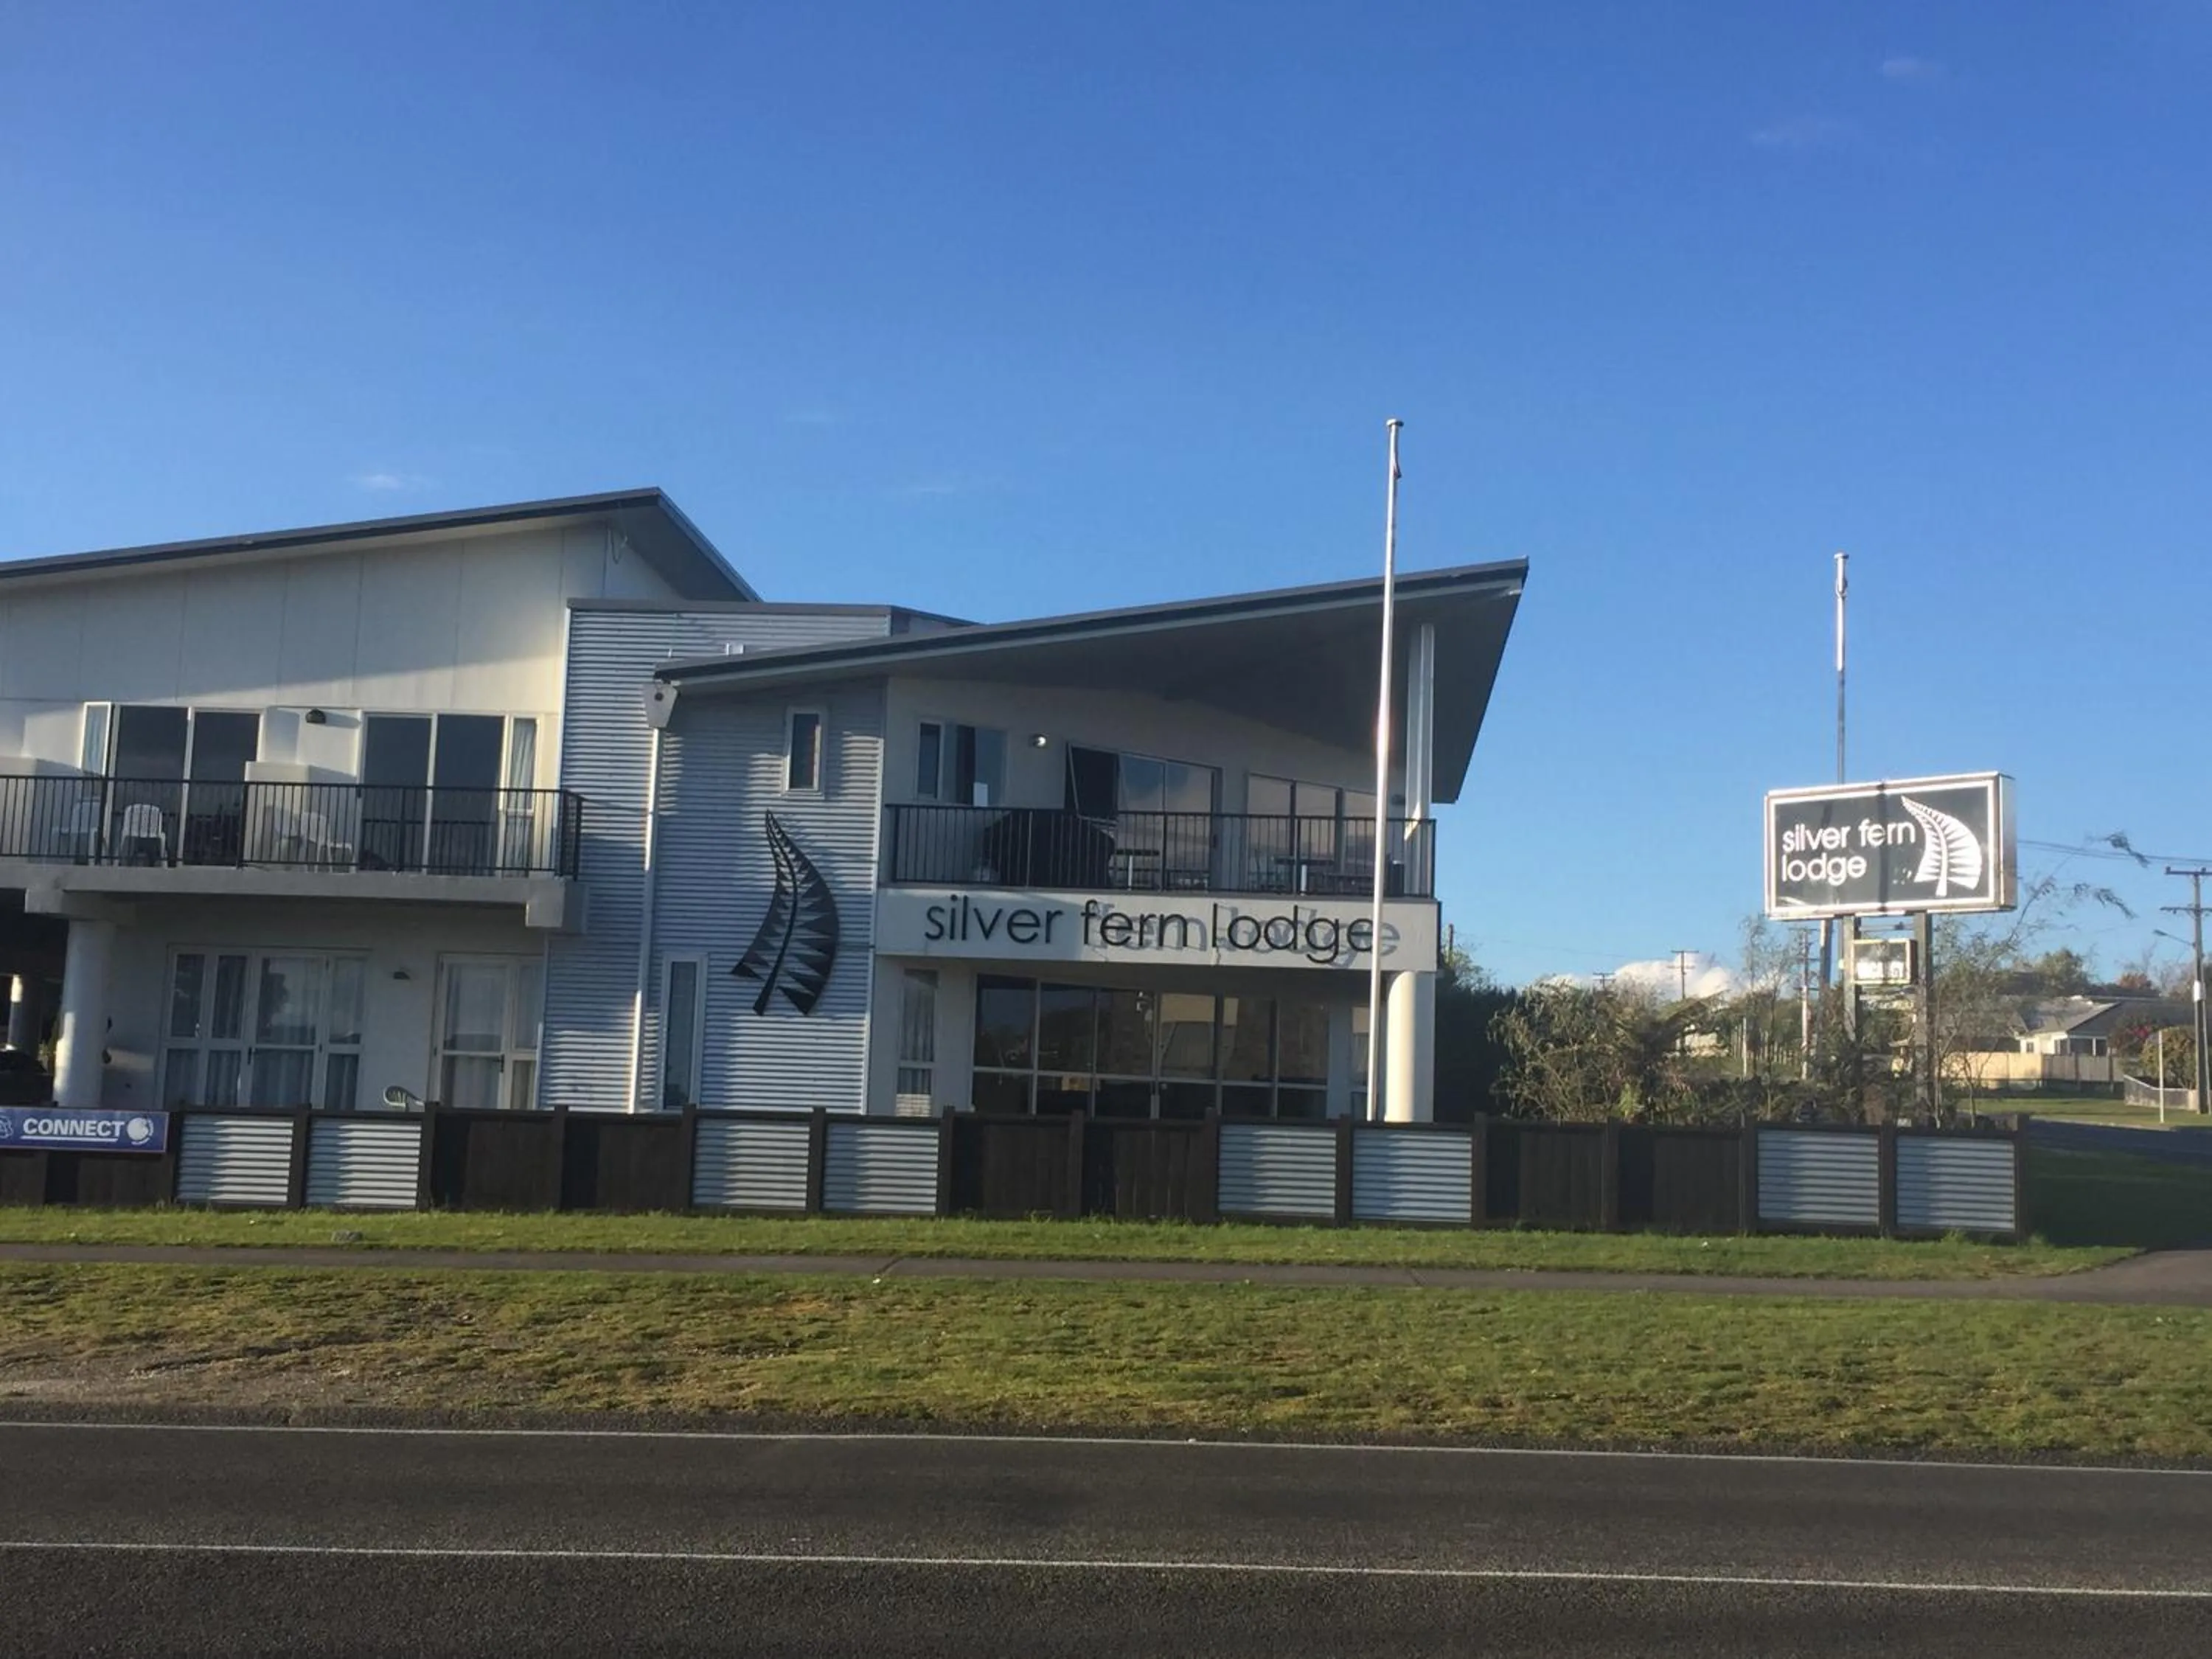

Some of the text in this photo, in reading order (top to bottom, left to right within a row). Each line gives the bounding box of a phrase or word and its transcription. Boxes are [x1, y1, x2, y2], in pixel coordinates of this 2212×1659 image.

[1782, 818, 1916, 852] silver fern
[1781, 852, 1868, 886] lodge
[925, 894, 1374, 964] silver fern lodge
[23, 1117, 125, 1138] CONNECT
